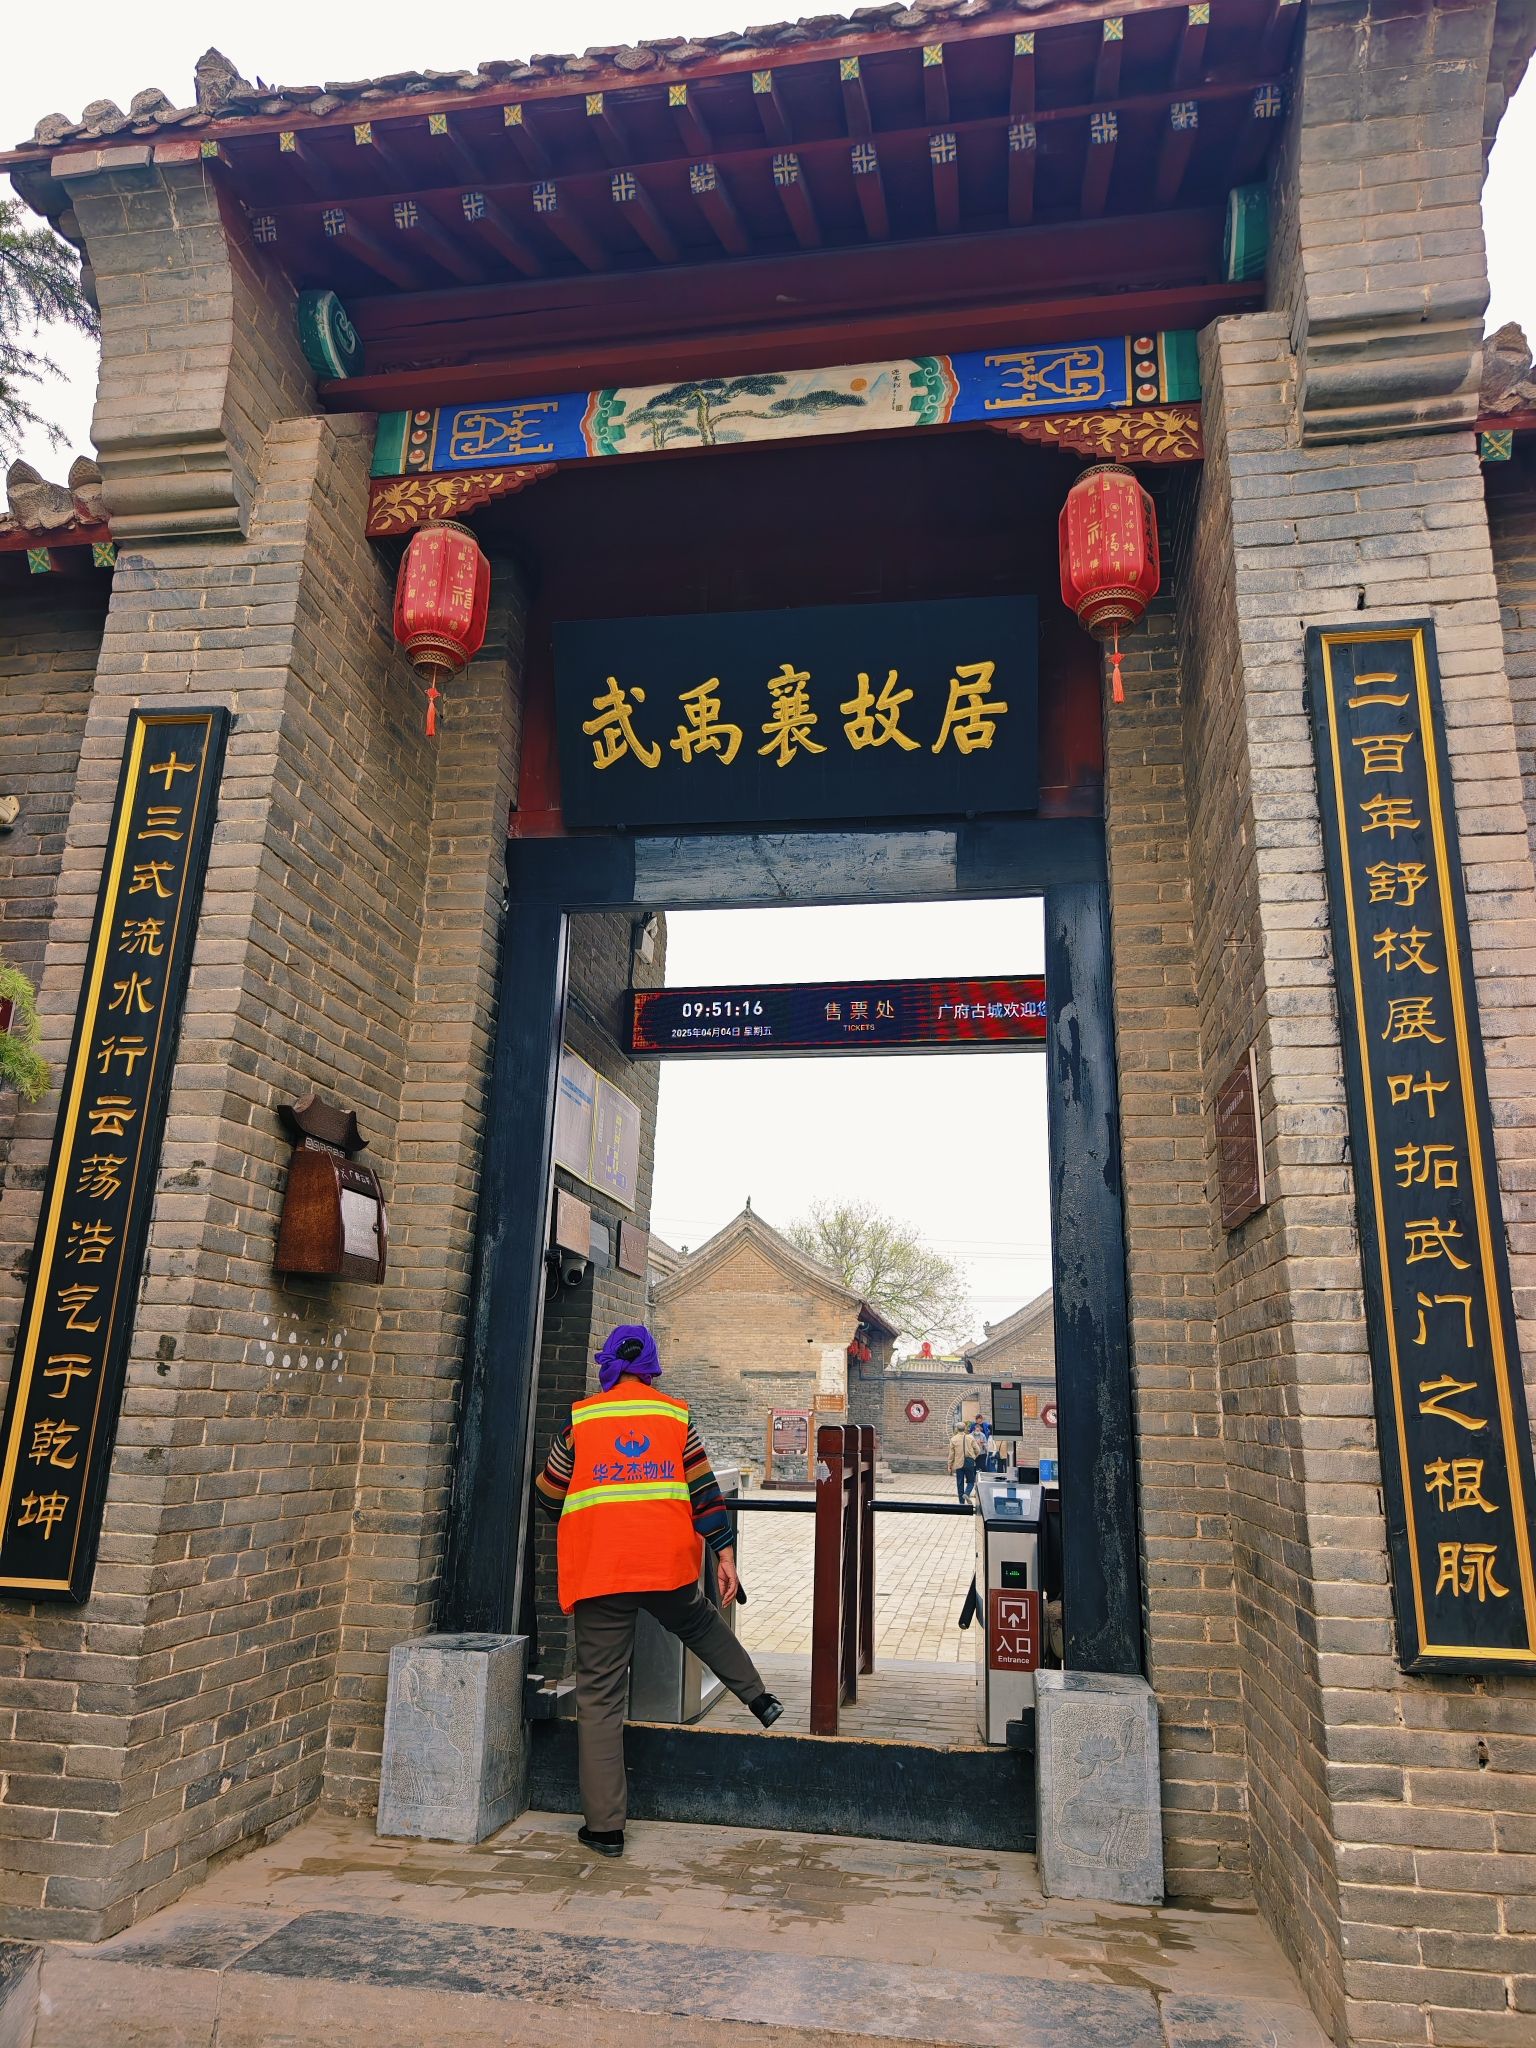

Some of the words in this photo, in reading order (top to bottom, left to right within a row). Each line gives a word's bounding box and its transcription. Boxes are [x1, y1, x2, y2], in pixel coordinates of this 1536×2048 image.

[582, 660, 1008, 769] 武禹襄故居
[682, 1001, 763, 1018] 09:51:16
[824, 1000, 895, 1022] 售票处
[671, 1027, 740, 1038] 2025年04月04日
[743, 1026, 772, 1036] 星期五
[843, 1024, 875, 1032] TICKETS
[17, 751, 196, 1540] 十三式流水行云荡浩气于乾坤
[1349, 673, 1509, 1602] 二百年舒枝展叶拓武门之根脉
[592, 1460, 675, 1483] 华之杰物业
[996, 1635, 1031, 1654] 入口
[997, 1655, 1030, 1665] Entrance
